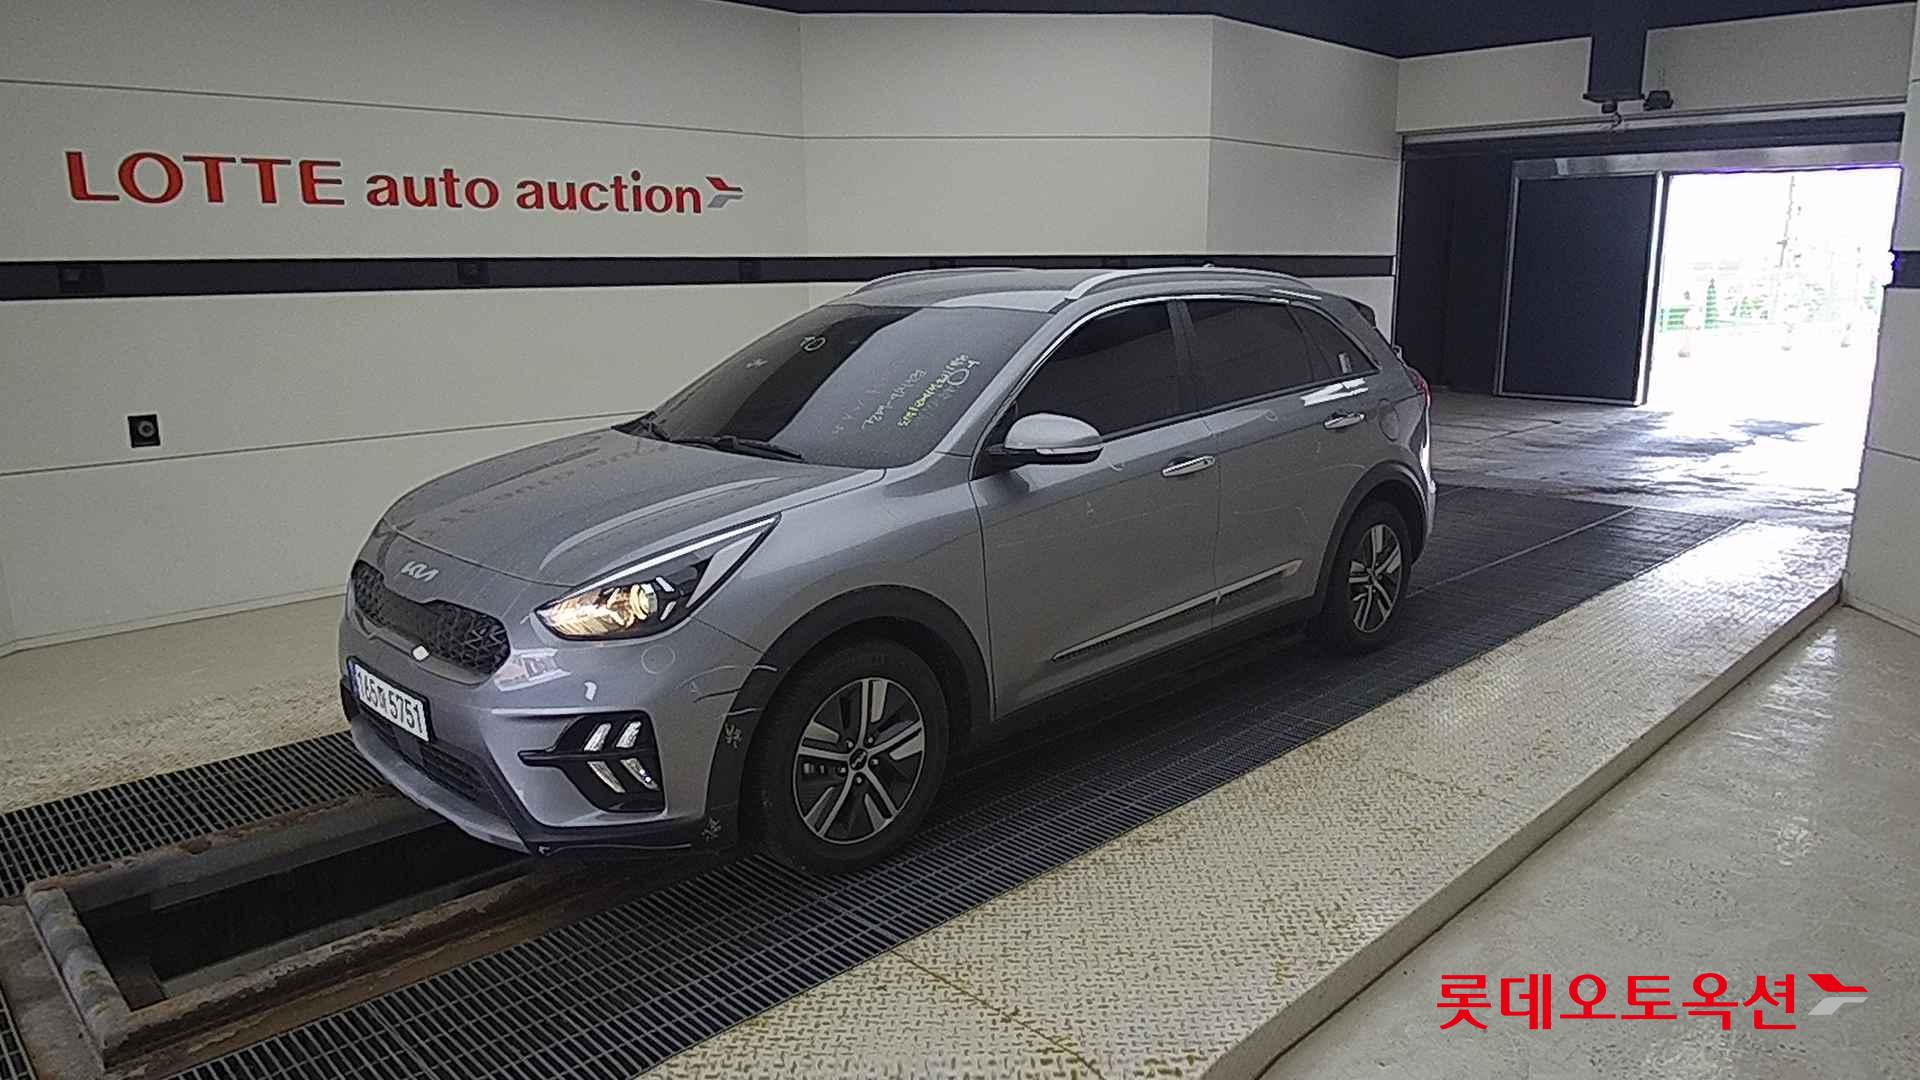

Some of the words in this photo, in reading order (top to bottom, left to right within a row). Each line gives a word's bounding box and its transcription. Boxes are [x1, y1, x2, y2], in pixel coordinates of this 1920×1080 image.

[65, 151, 345, 206] LOTTE
[366, 167, 500, 210] auto
[516, 169, 703, 215] auction
[401, 560, 440, 582] KIA
[388, 689, 423, 734] 5751
